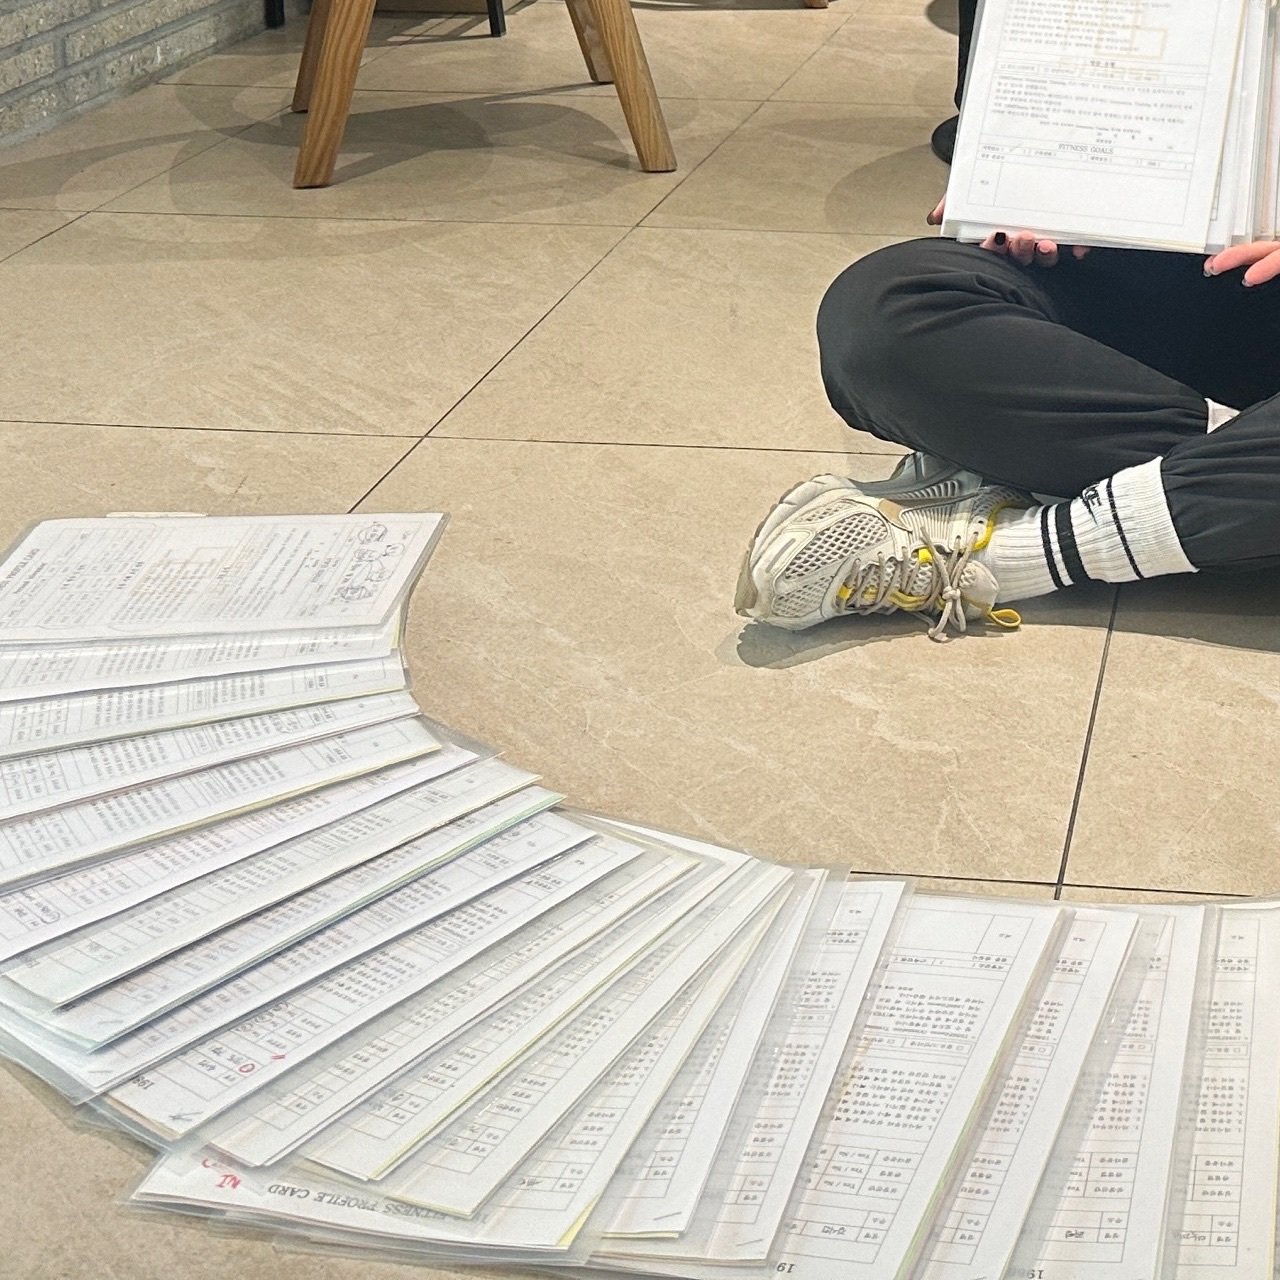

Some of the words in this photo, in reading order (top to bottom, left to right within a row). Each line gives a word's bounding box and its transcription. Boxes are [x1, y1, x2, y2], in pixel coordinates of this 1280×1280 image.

[1058, 143, 1088, 153] FITNESS
[1090, 145, 1114, 155] GOALS
[267, 1183, 311, 1199] CARD
[313, 1190, 377, 1213] PROFILE
